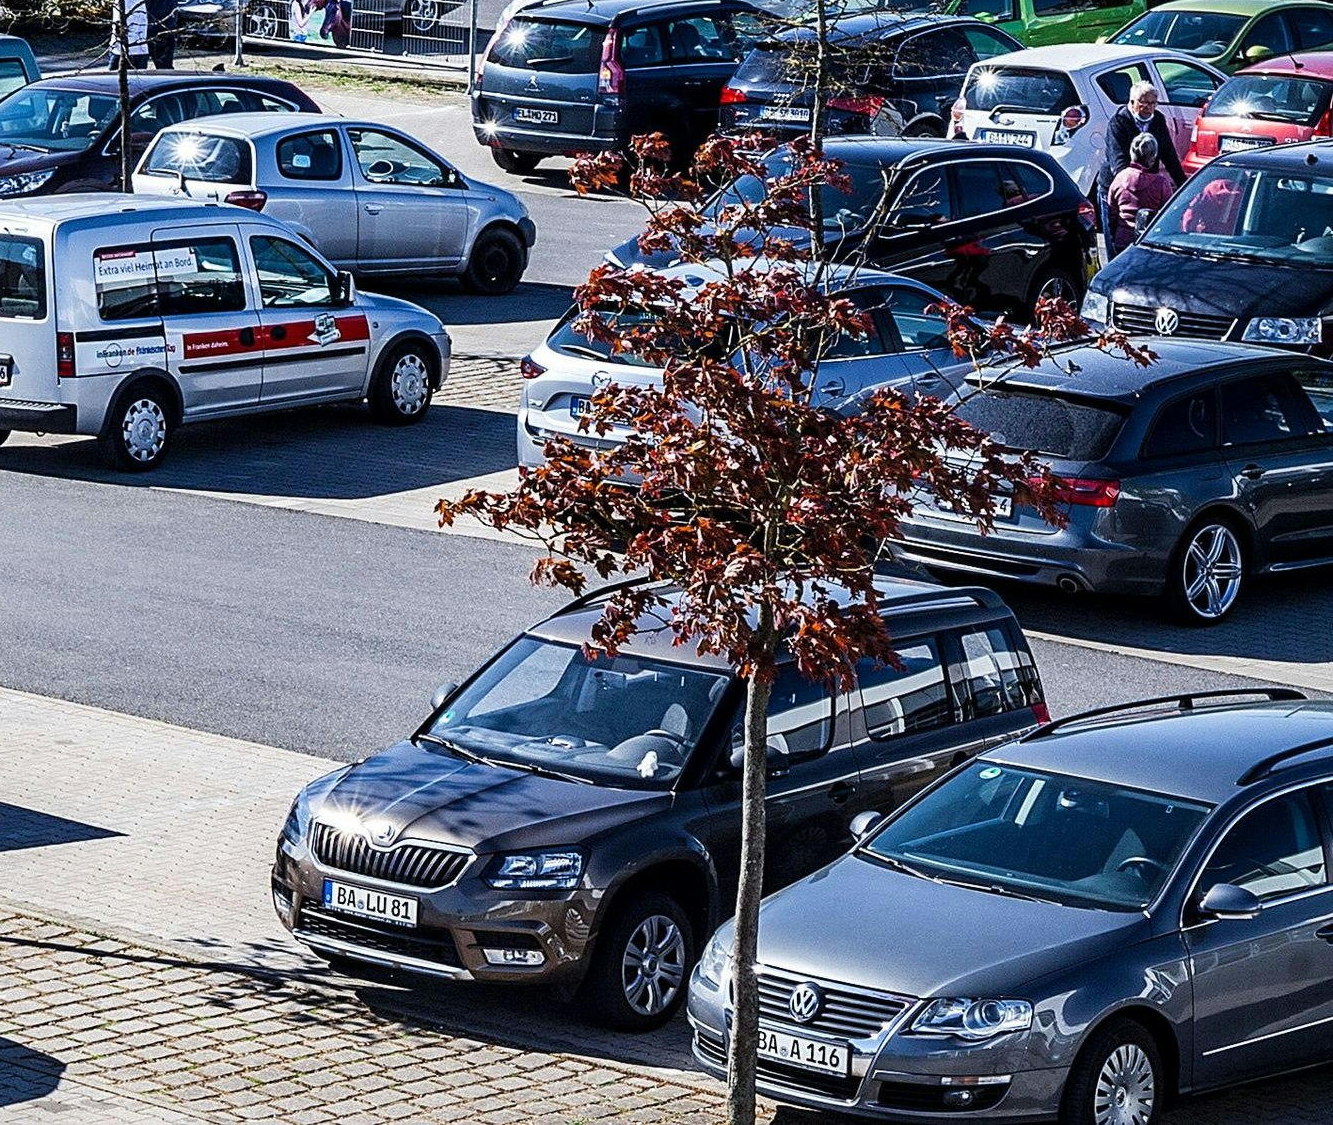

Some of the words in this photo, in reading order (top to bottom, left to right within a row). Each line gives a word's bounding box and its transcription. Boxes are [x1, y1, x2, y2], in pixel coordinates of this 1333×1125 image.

[543, 112, 557, 122] 271
[1013, 134, 1028, 145] 244
[99, 266, 119, 276] Extra
[120, 264, 134, 273] viel
[165, 261, 174, 269] an
[337, 886, 356, 908] BA
[367, 893, 387, 915] LU
[391, 899, 411, 920] 81
[757, 1030, 778, 1054] BA
[789, 1039, 801, 1060] A
[806, 1043, 840, 1068] 116
